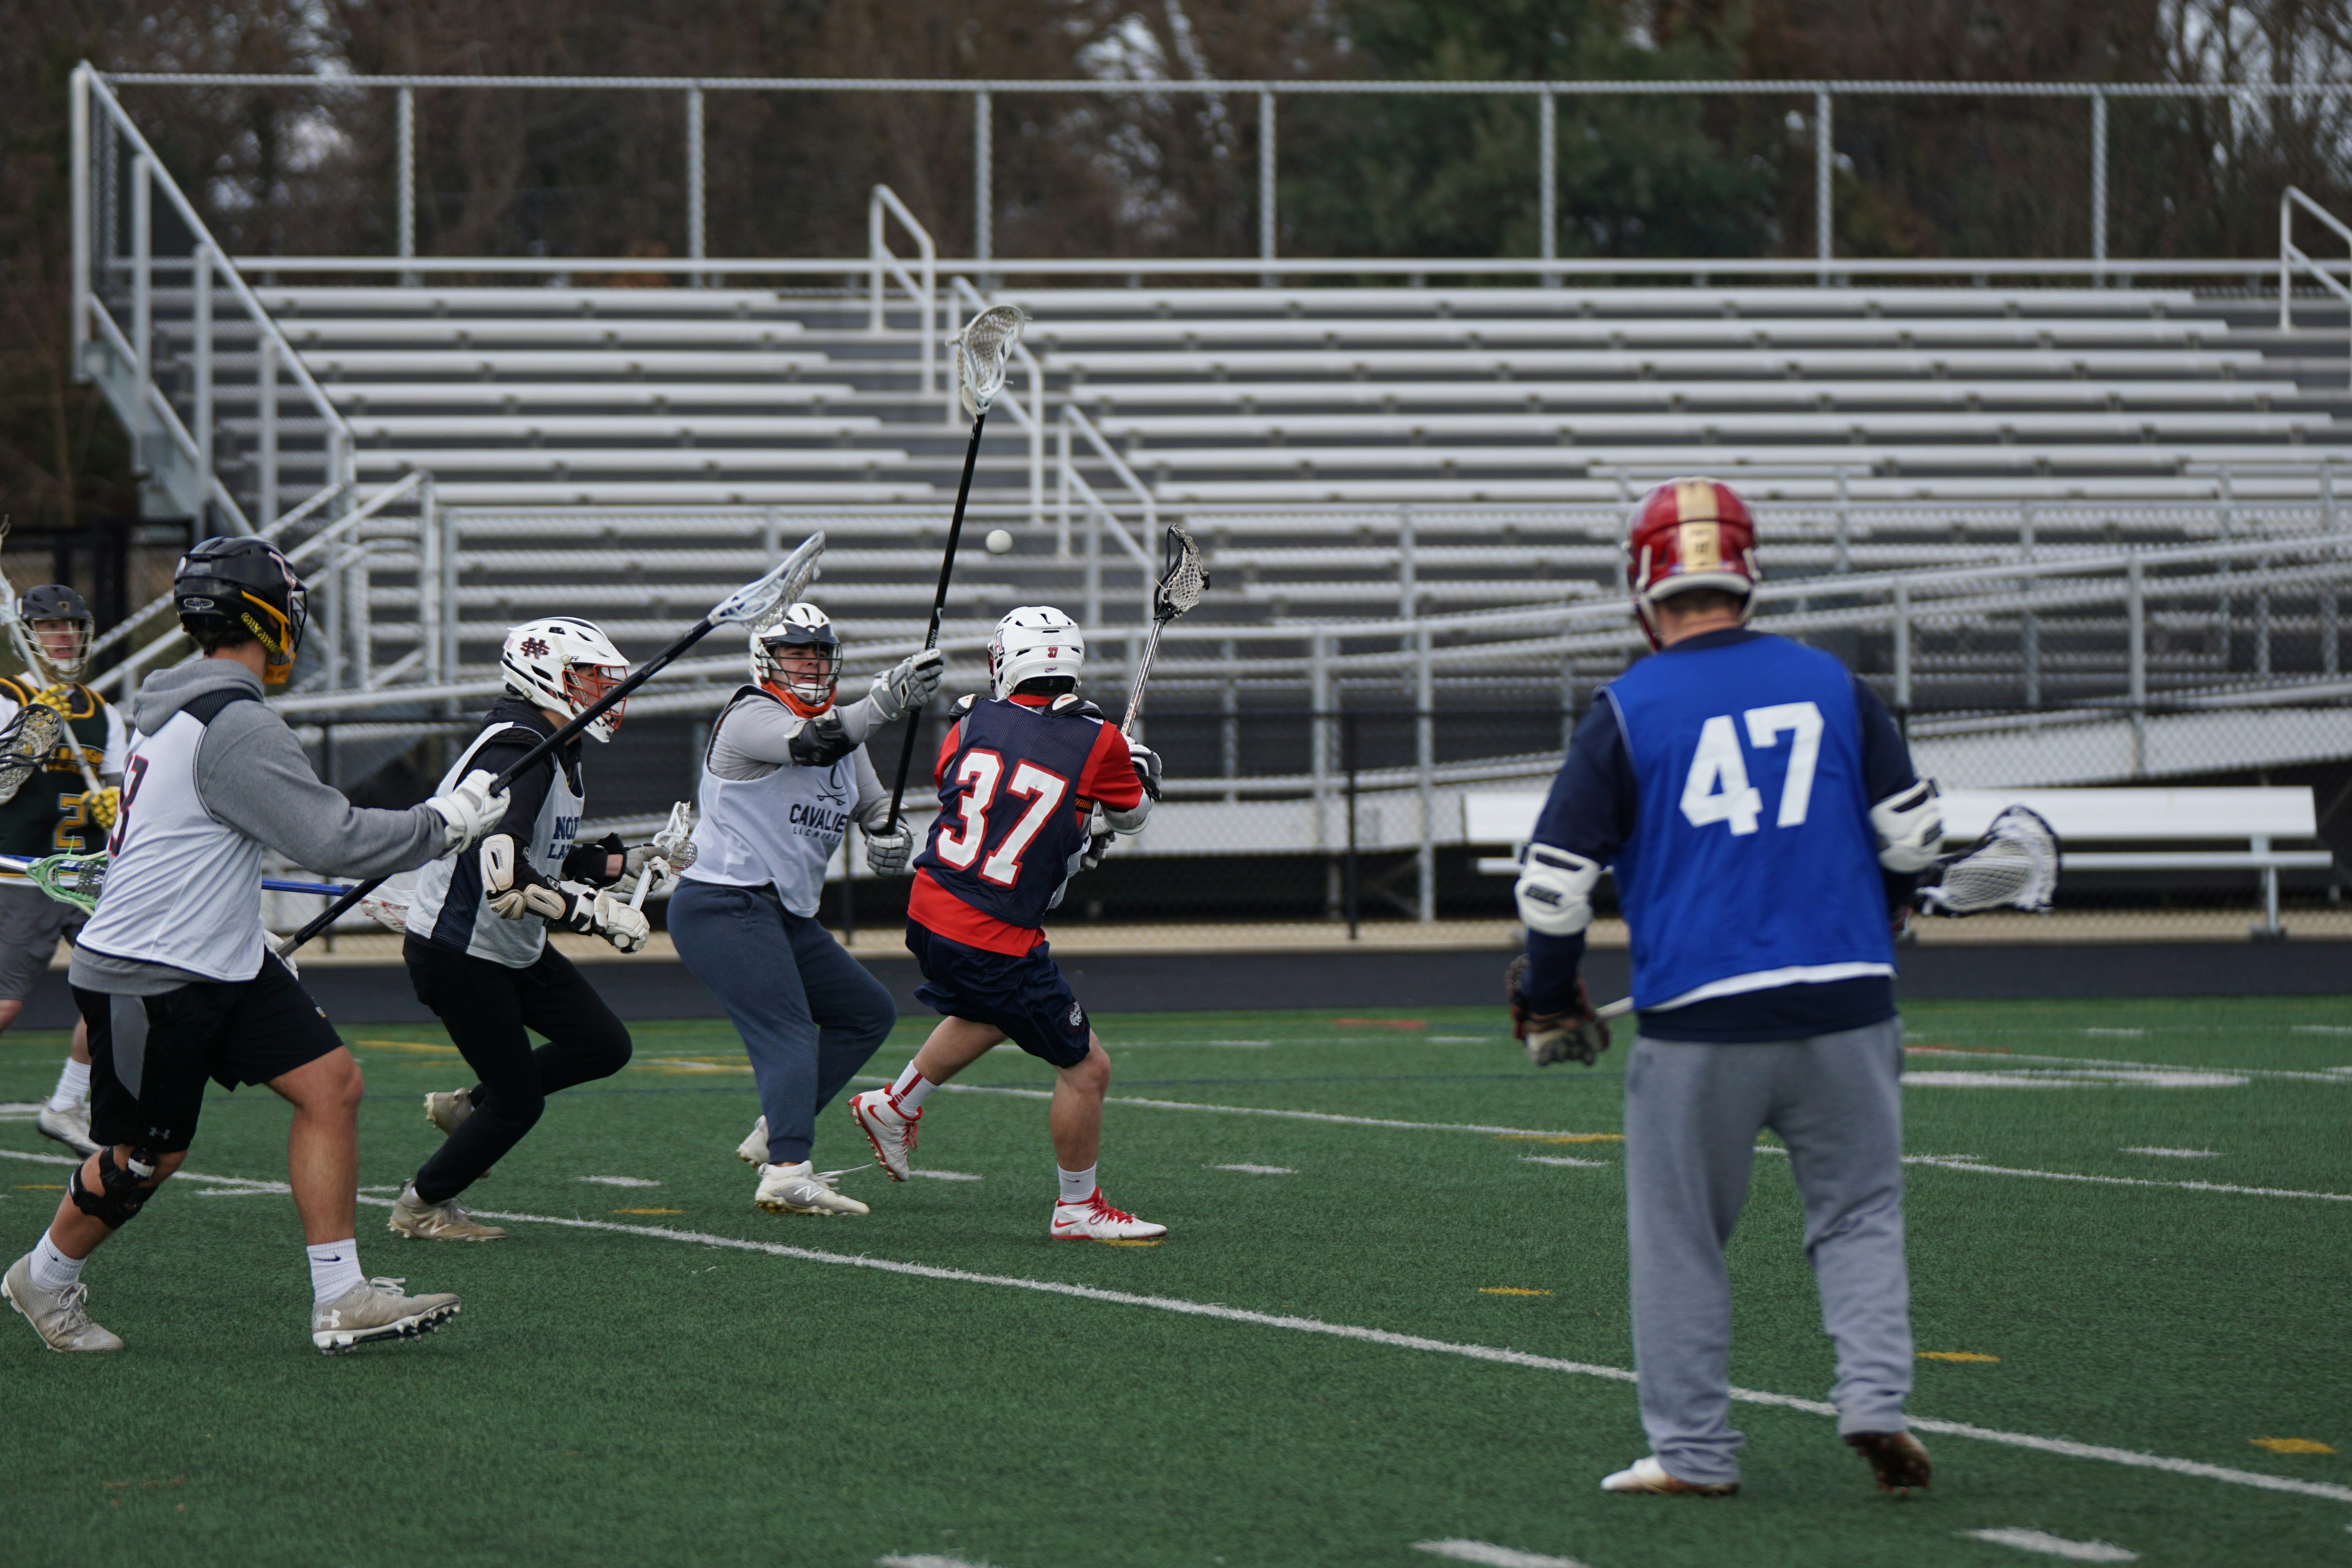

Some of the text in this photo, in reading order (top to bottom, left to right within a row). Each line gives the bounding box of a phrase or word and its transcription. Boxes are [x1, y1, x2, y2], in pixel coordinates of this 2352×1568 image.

[1047, 647, 1058, 658] 37
[1680, 701, 1825, 837] 47
[53, 793, 89, 850] 2
[936, 748, 1070, 889] 37
